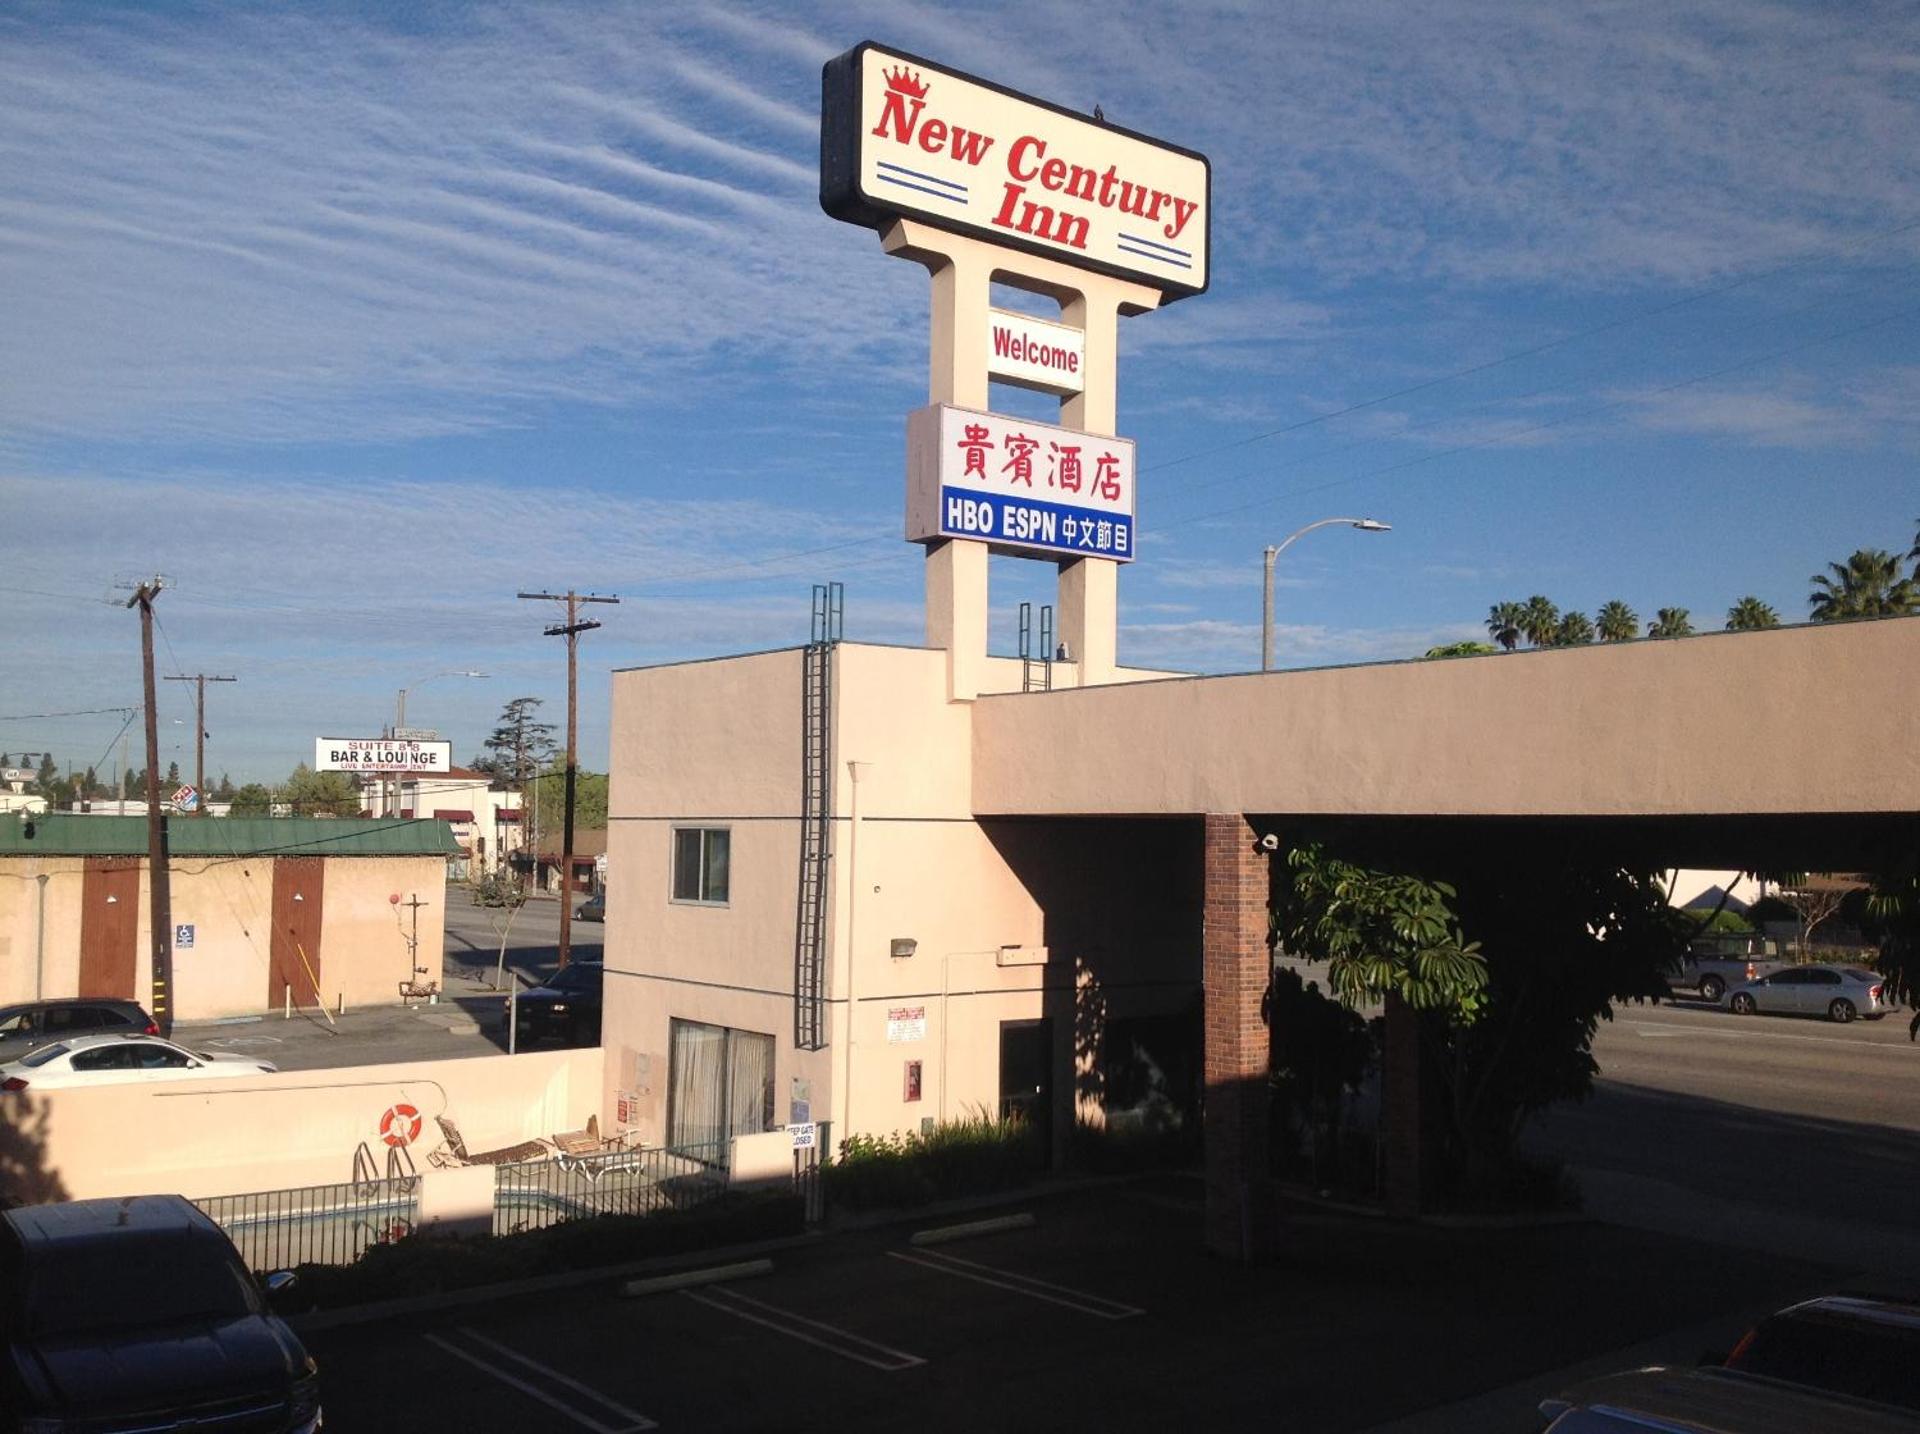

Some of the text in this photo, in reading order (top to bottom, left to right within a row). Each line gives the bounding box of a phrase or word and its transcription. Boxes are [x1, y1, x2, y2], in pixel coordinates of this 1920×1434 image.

[872, 89, 1199, 239] New Century
[991, 181, 1091, 250] Inn
[993, 326, 1079, 373] Welcome
[957, 423, 1121, 501] 貴賓酒店
[948, 497, 1128, 551] HBO ESPN 中文節目
[331, 750, 437, 764] BAR & LOUNGE
[348, 742, 393, 751] SUITE
